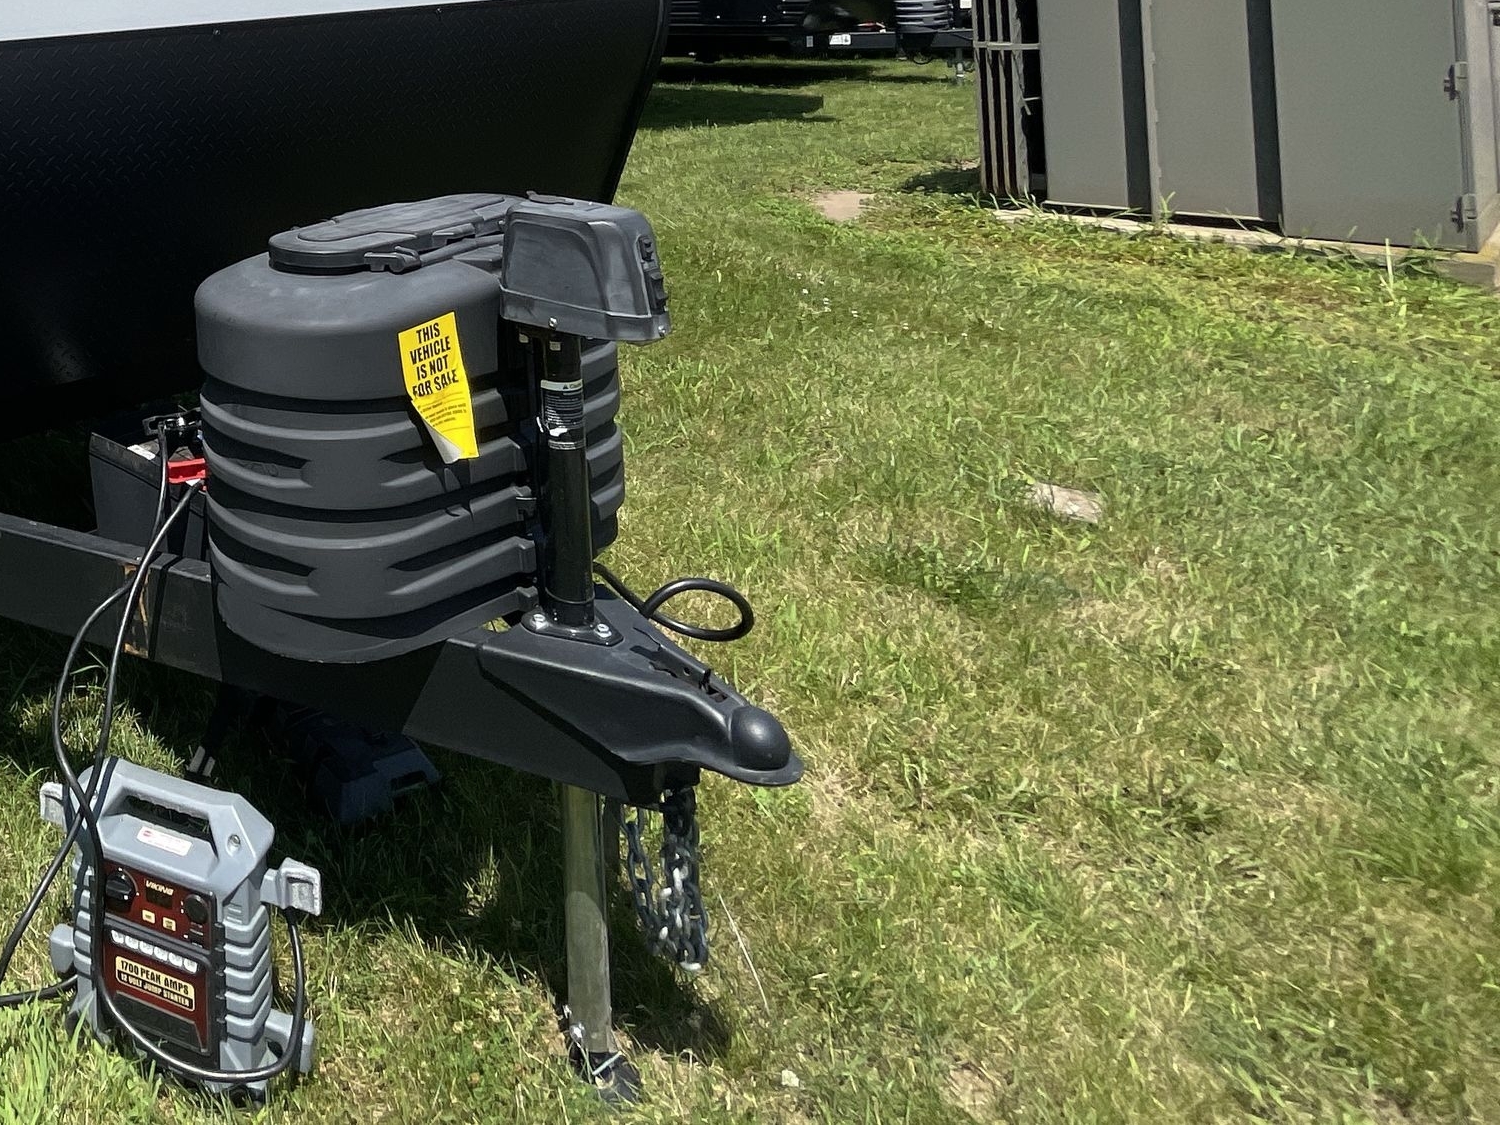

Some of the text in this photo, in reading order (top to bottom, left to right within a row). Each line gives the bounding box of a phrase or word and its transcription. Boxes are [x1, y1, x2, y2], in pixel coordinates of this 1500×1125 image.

[416, 322, 440, 343] THIS
[410, 336, 451, 365] VEHICLE
[416, 354, 449, 381] IS NOT
[412, 369, 459, 398] FOR SALE
[145, 880, 175, 895] VIKING
[120, 960, 189, 995] 1700 PEAK AMPS
